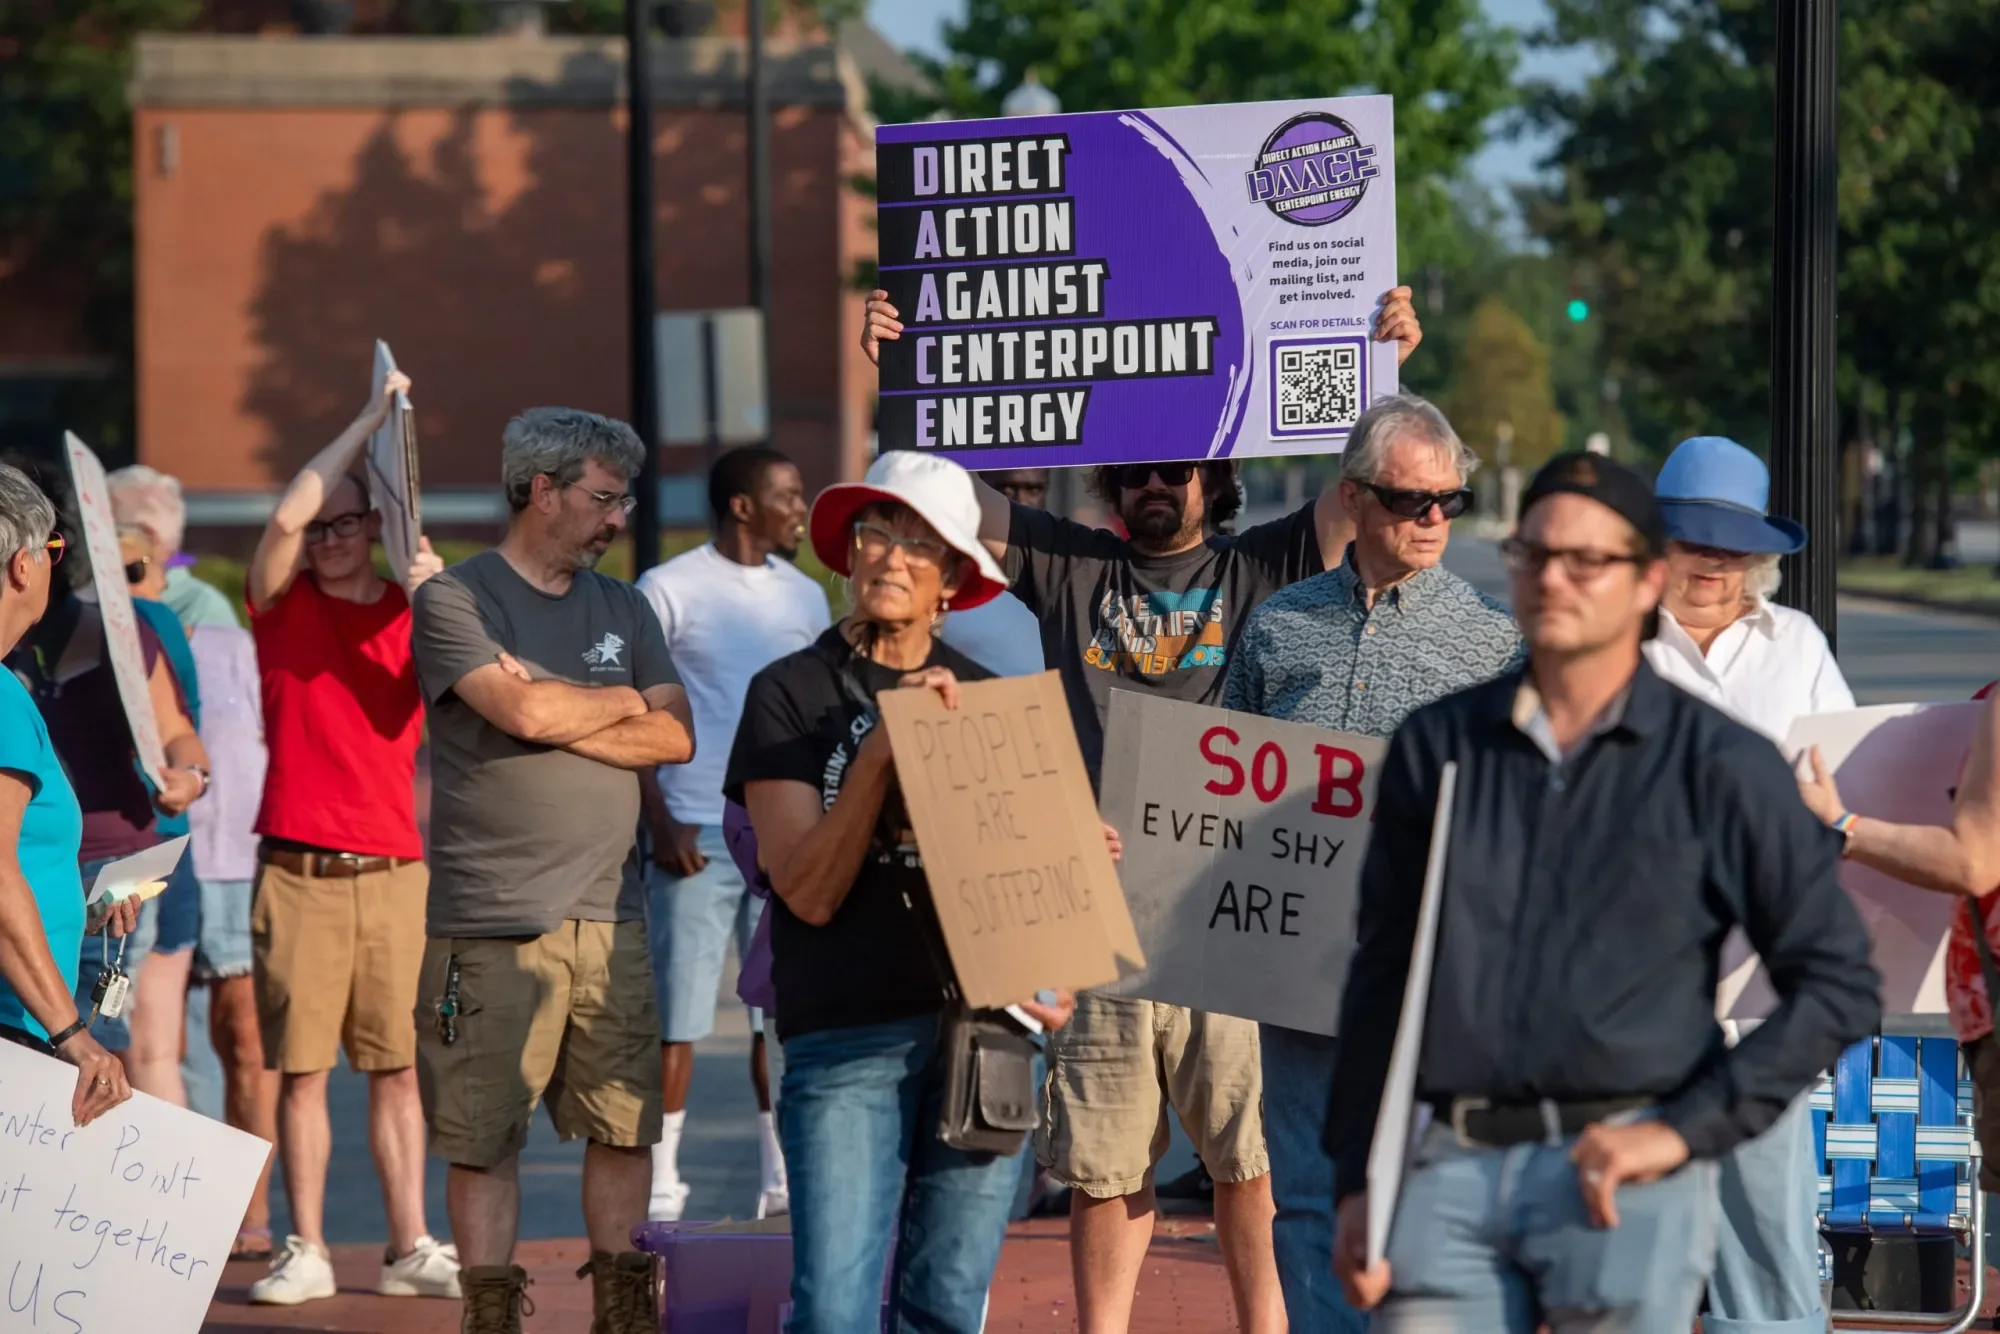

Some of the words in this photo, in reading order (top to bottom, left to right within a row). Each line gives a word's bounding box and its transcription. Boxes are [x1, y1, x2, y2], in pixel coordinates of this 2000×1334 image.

[913, 138, 1065, 196] DIRECT
[1245, 144, 1380, 204] DAACE
[1262, 152, 1290, 165] DIRECT
[1292, 143, 1320, 158] ACTION
[1321, 135, 1355, 152] AGAINST
[1275, 192, 1329, 212] CENTERPOINT
[1330, 185, 1361, 201] ENERGY
[914, 202, 1071, 259] ACTION
[1268, 241, 1294, 252] Find
[1297, 242, 1310, 250] us
[1313, 240, 1328, 249] on
[1330, 237, 1365, 248] social
[1269, 274, 1314, 286] mailing
[1316, 273, 1339, 284] list,
[1342, 271, 1364, 282] and
[1272, 257, 1313, 269] media,
[1315, 255, 1338, 269] join
[1341, 256, 1361, 265] our
[915, 264, 1105, 322] AGAINST
[1279, 292, 1299, 304] get
[1301, 289, 1355, 301] involved.
[1270, 320, 1297, 330] SCAN
[1300, 319, 1319, 329] FOR
[1322, 317, 1365, 328] DETAILS:
[916, 321, 1214, 384] CENTERPOINT
[916, 391, 1086, 447] ENERGY
[914, 704, 1059, 797] PEOPLE
[1199, 725, 1288, 803] SO
[1311, 743, 1377, 824] B
[974, 790, 1027, 846] ARE
[1143, 802, 1244, 850] EVEN
[1271, 827, 1345, 868] SHY
[958, 855, 1092, 936] SUFFERING
[1209, 880, 1305, 937] ARE
[54, 1183, 209, 1281] together
